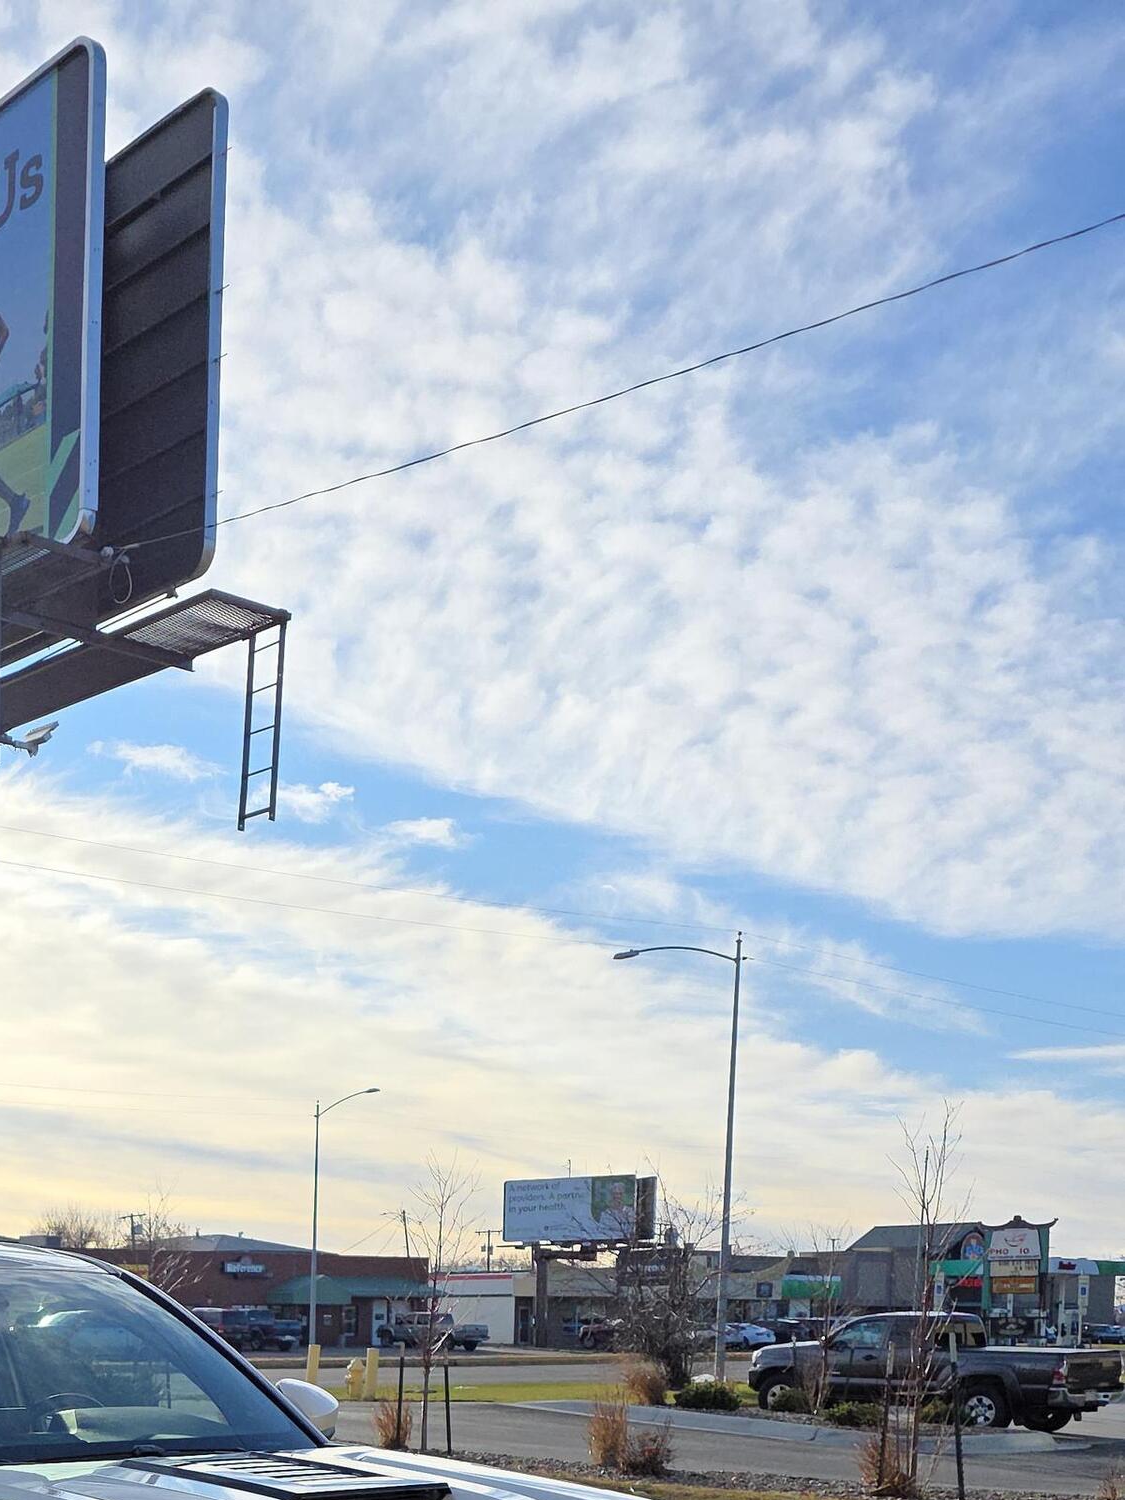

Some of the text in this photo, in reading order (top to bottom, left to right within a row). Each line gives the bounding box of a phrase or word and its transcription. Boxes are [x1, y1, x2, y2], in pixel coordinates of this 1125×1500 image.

[517, 1183, 549, 1192] network
[551, 1181, 561, 1190] of
[556, 1191, 586, 1202] partn
[518, 1205, 537, 1215] your
